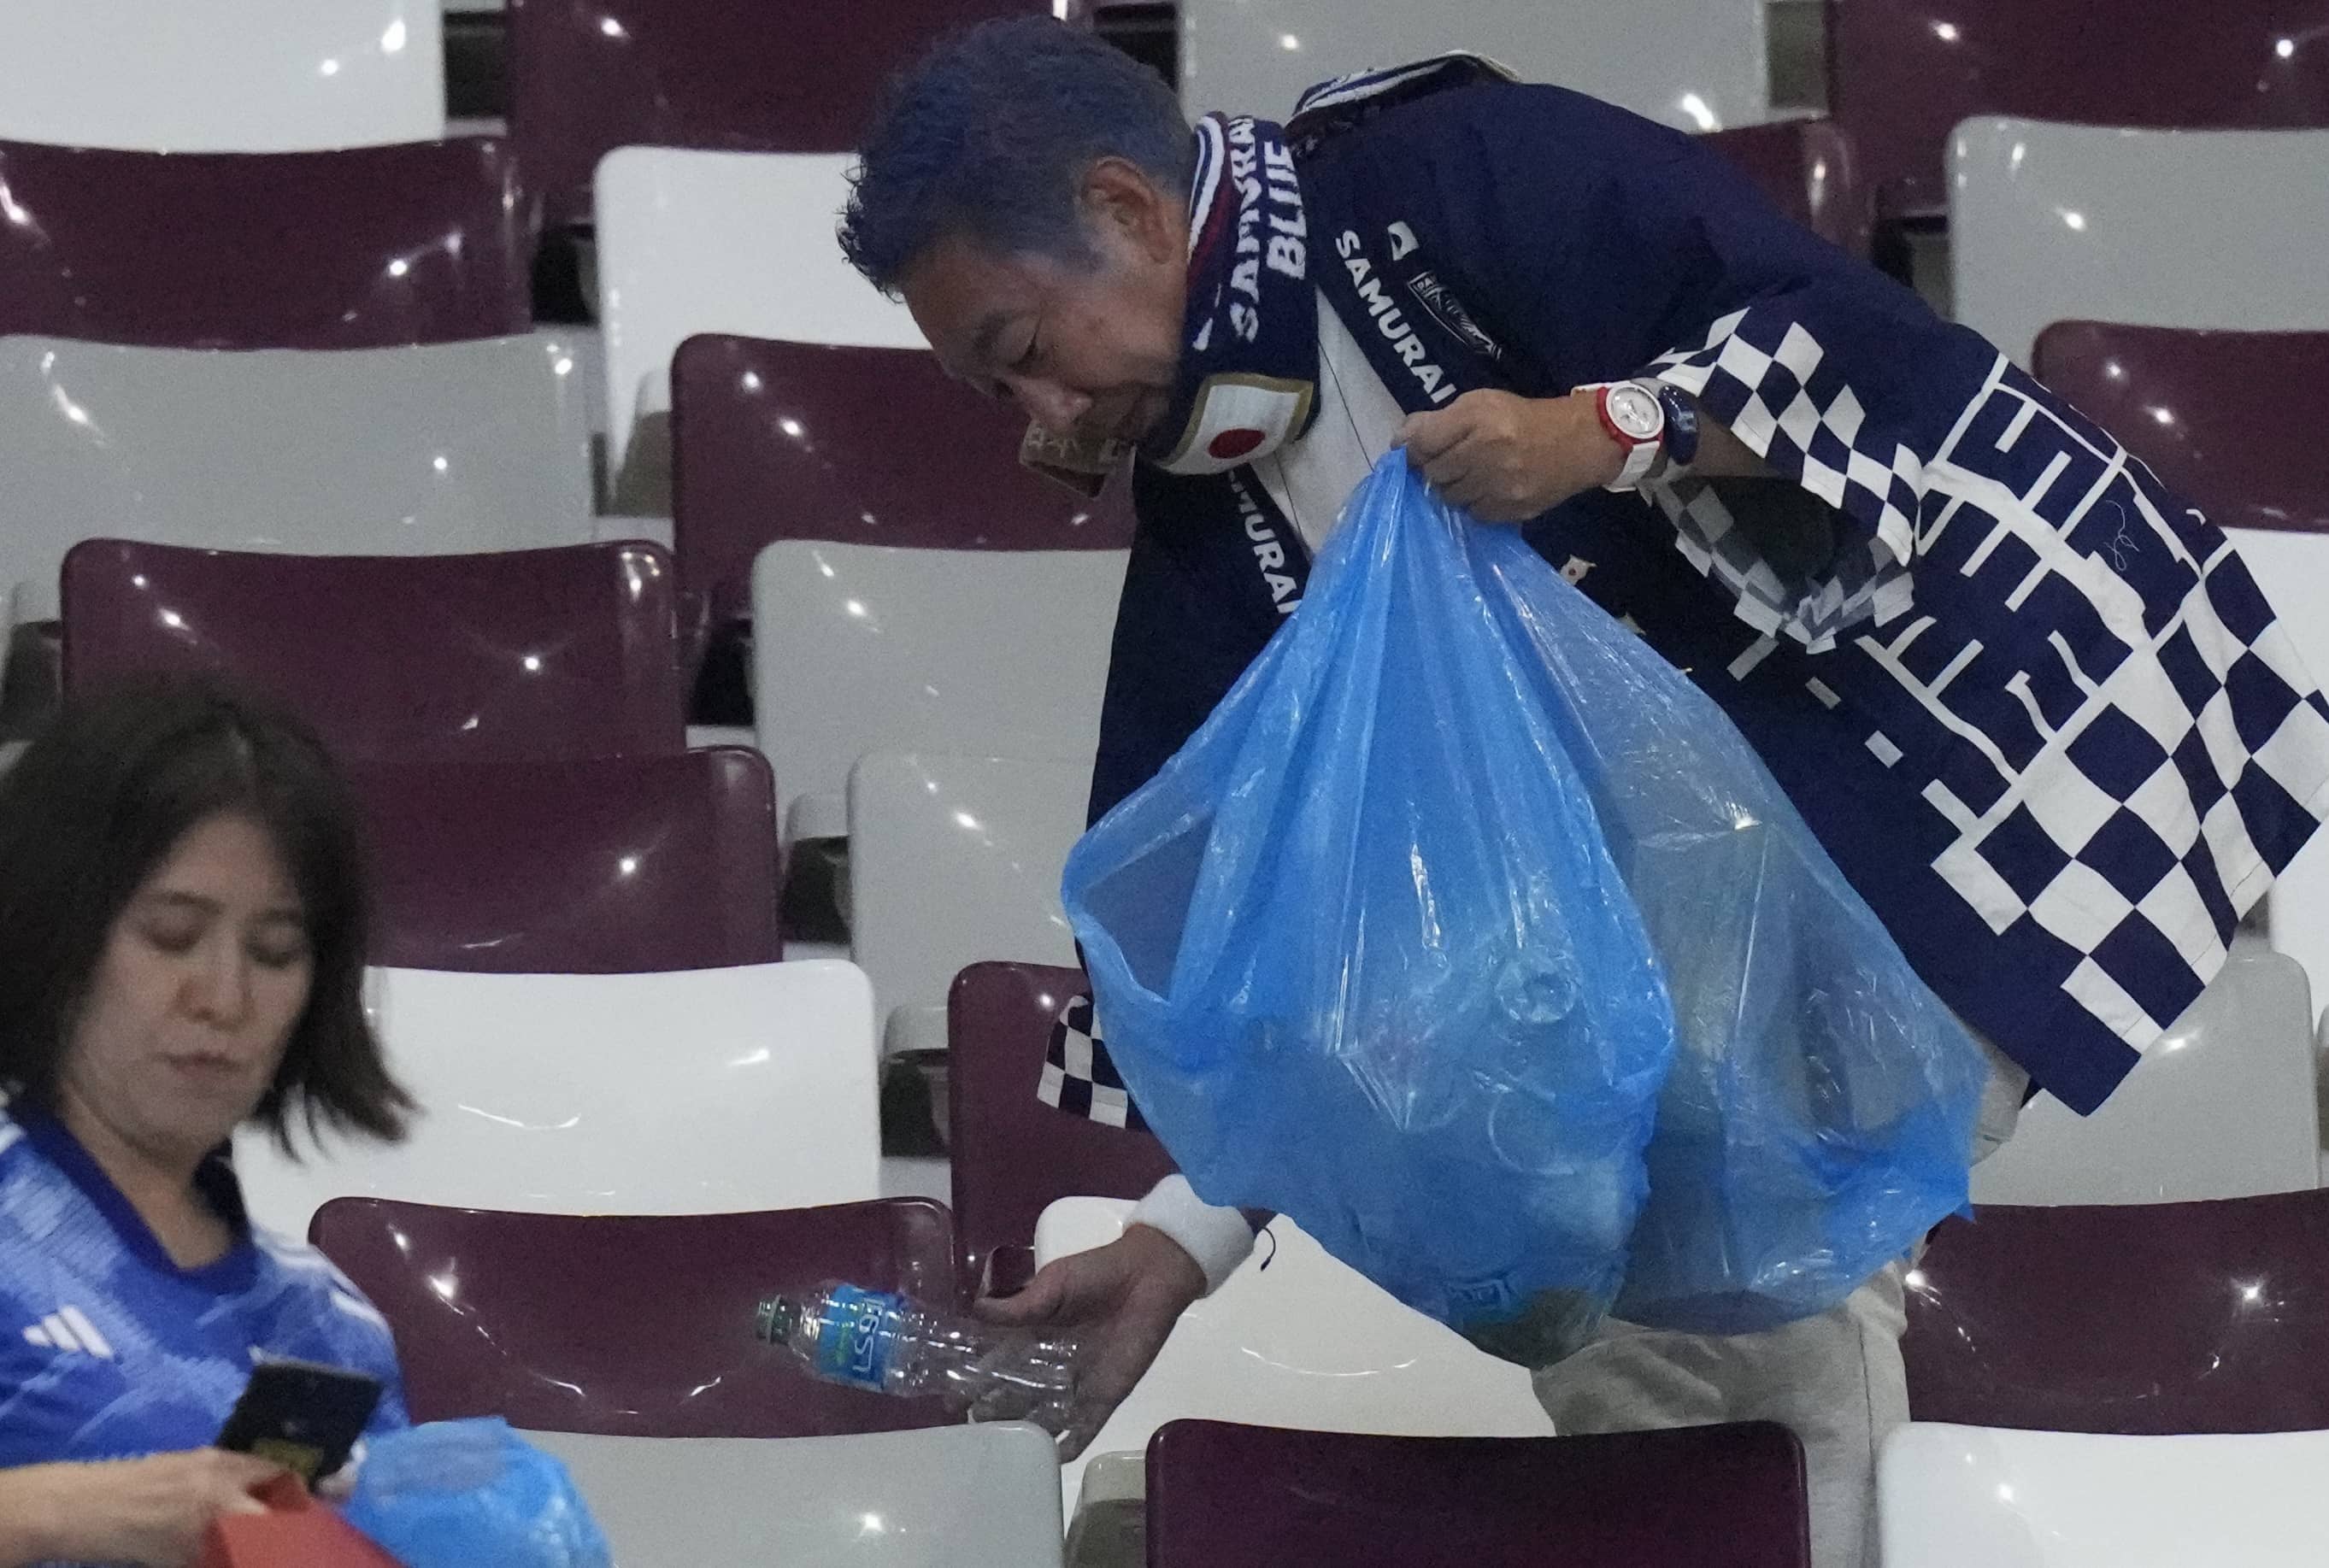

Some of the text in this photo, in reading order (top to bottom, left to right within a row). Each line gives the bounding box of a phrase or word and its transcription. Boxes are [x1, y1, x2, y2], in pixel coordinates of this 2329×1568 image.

[1266, 140, 1308, 279] BLUE
[1335, 230, 1456, 403] SAMURAI
[1229, 472, 1302, 614] MURAI
